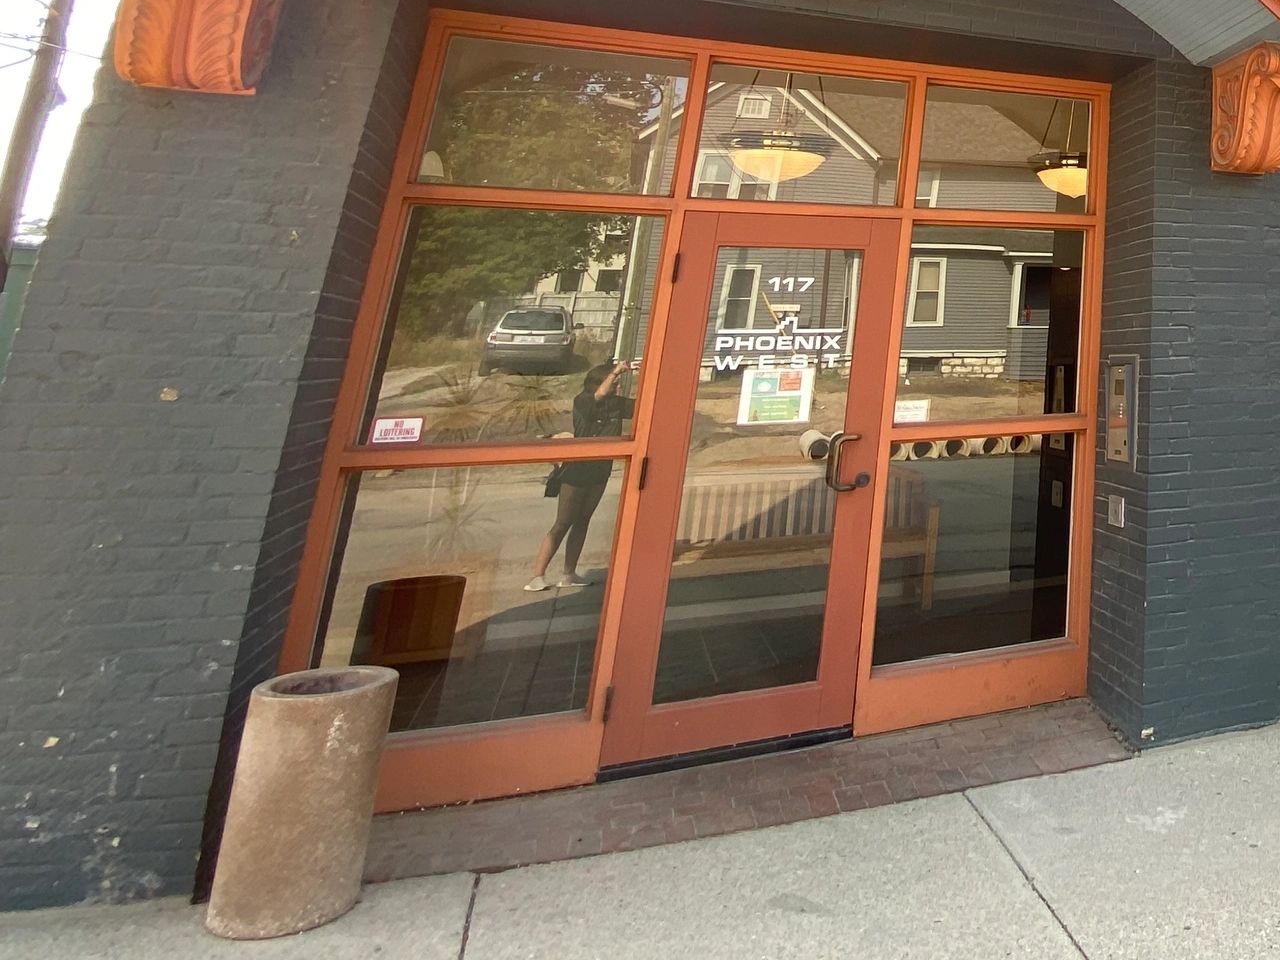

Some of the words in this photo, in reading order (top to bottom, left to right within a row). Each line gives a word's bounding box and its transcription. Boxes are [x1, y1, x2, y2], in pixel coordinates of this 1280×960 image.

[768, 276, 815, 292] 117
[714, 335, 842, 351] PHOENIX
[394, 420, 404, 428] NO
[380, 428, 415, 436] LOITERING
